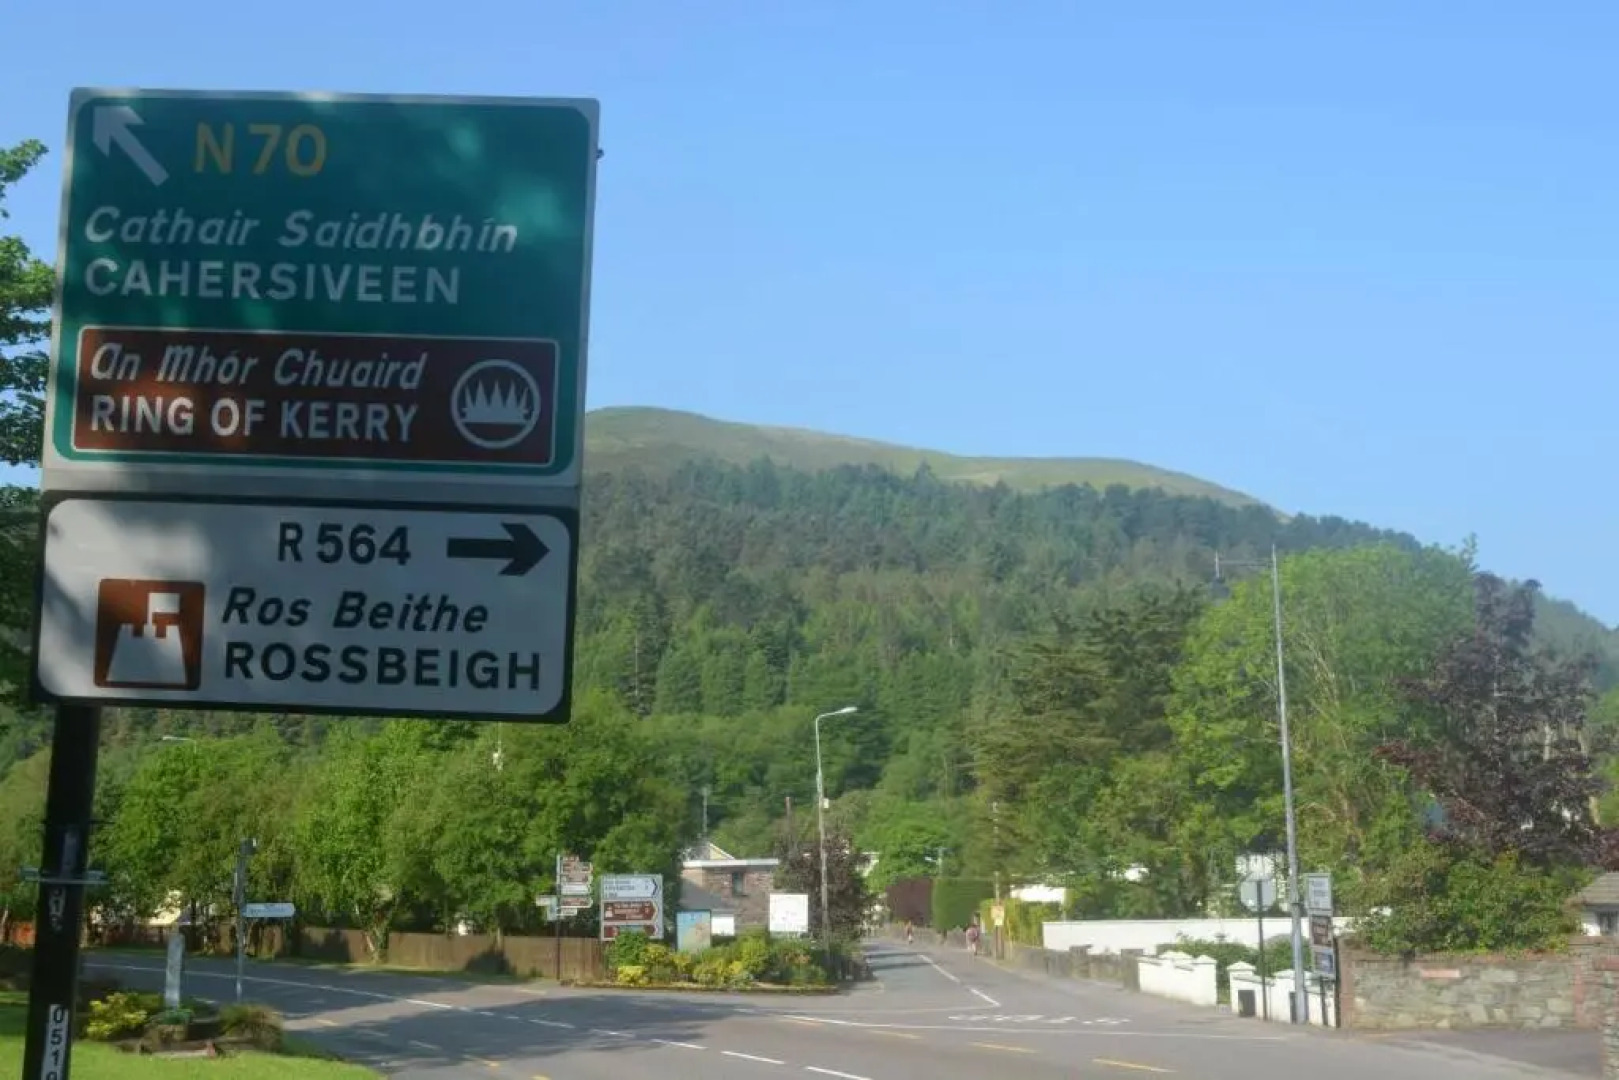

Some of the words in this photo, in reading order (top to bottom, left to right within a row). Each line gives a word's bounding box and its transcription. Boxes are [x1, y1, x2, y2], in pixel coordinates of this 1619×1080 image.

[85, 205, 259, 246] Cathair
[277, 209, 518, 254] Saidhbhín
[84, 257, 460, 304] CAHERSIVEEN
[90, 342, 140, 381] An
[154, 343, 259, 386] Mhór
[273, 347, 428, 389] Chuaird
[90, 395, 194, 434] RING
[210, 397, 265, 437] OF
[279, 400, 420, 443] KERRY
[221, 586, 310, 627] Ros
[332, 590, 489, 633] Beithe
[224, 641, 541, 691] ROSSBEIGH
